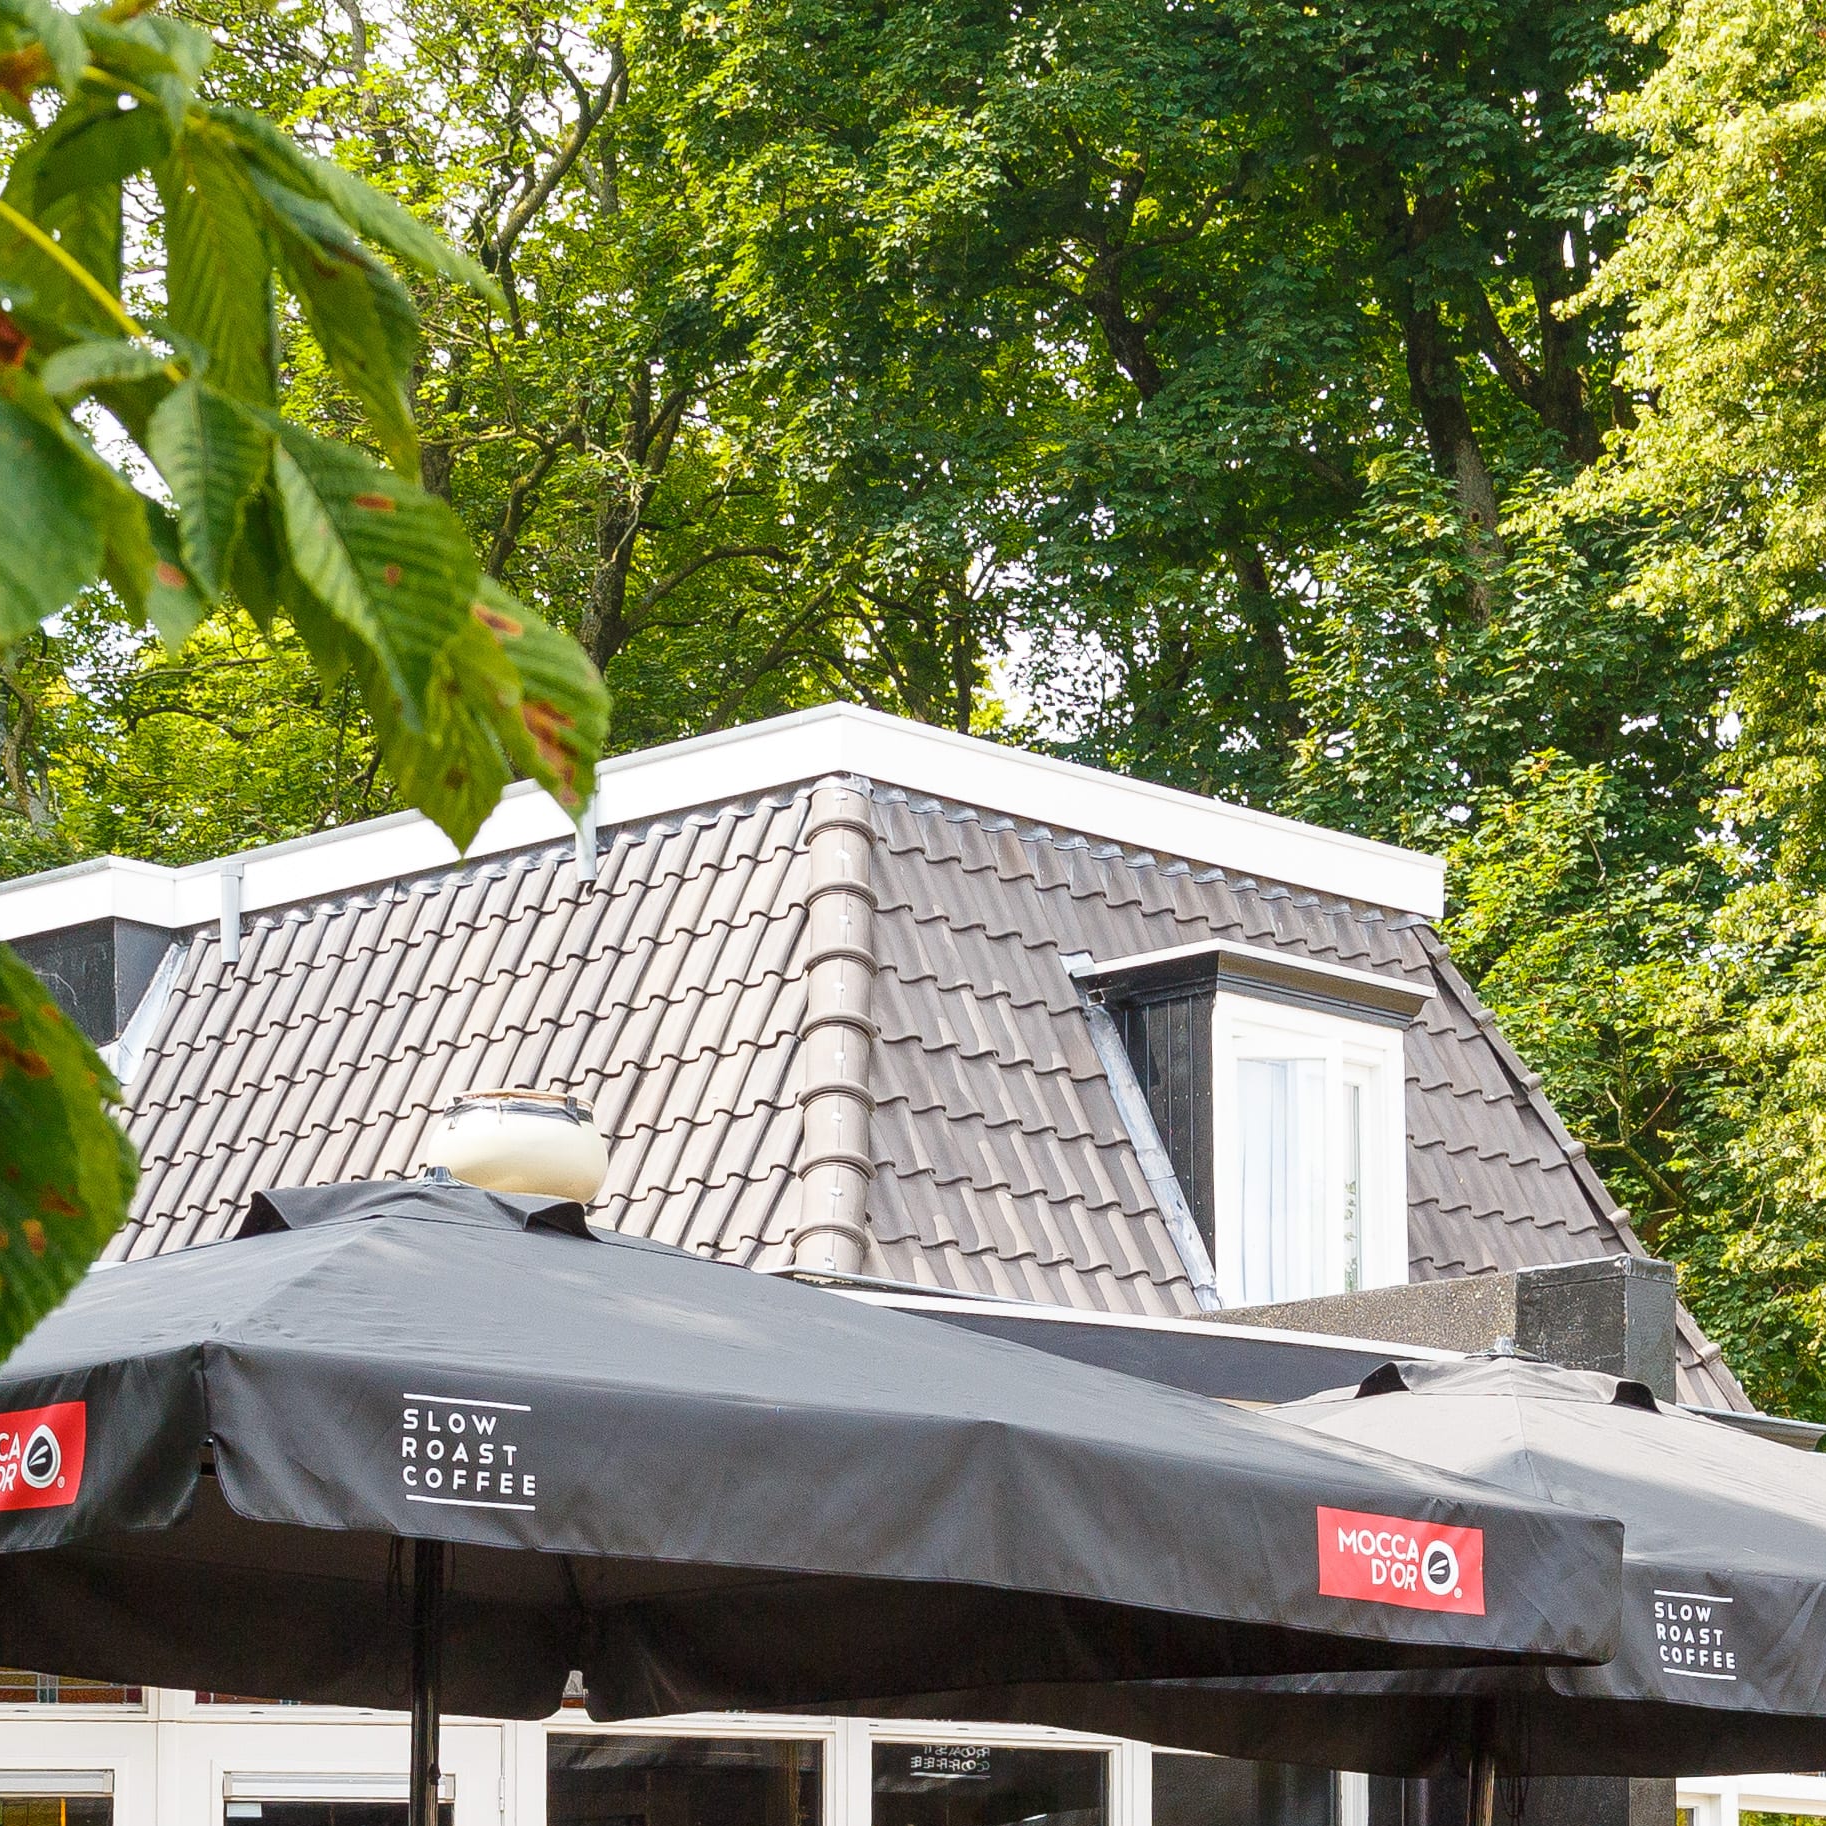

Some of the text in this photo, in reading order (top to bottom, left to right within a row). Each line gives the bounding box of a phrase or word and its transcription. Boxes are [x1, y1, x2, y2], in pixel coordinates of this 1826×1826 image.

[402, 1408, 497, 1436] SLOW
[401, 1437, 518, 1466] ROAST
[402, 1465, 536, 1496] COFFEE
[1337, 1527, 1419, 1563] MOCCA
[1370, 1558, 1418, 1592] D'OR
[1655, 1601, 1711, 1622] SLOW
[1656, 1622, 1723, 1646] ROAST
[1659, 1645, 1735, 1669] COFFEE
